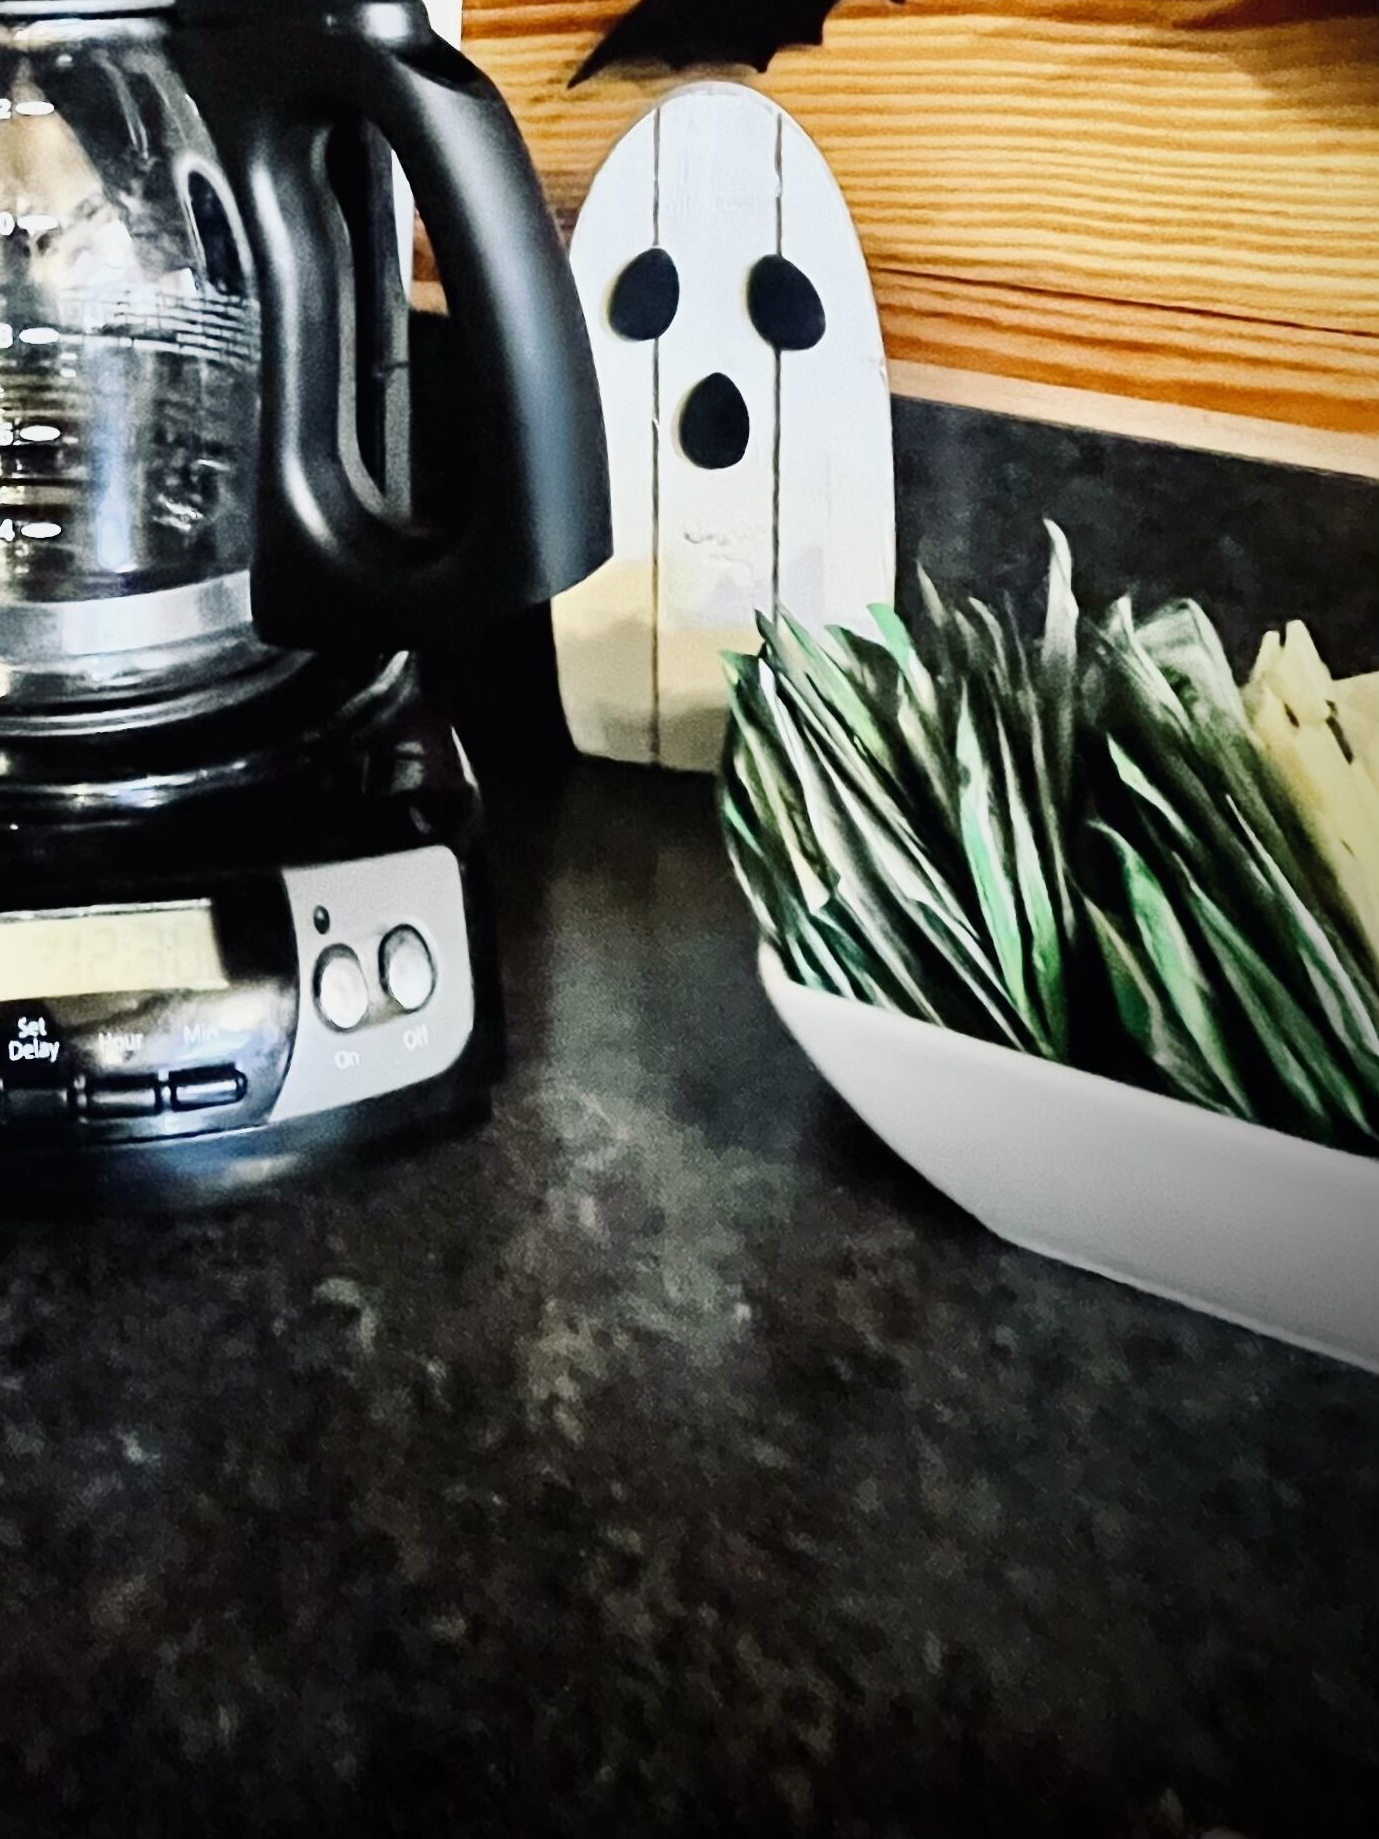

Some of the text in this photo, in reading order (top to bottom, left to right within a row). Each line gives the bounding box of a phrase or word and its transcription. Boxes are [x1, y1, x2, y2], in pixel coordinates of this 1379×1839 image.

[17, 1017, 47, 1039] Set
[8, 1038, 60, 1063] Delay
[334, 1050, 360, 1070] On
